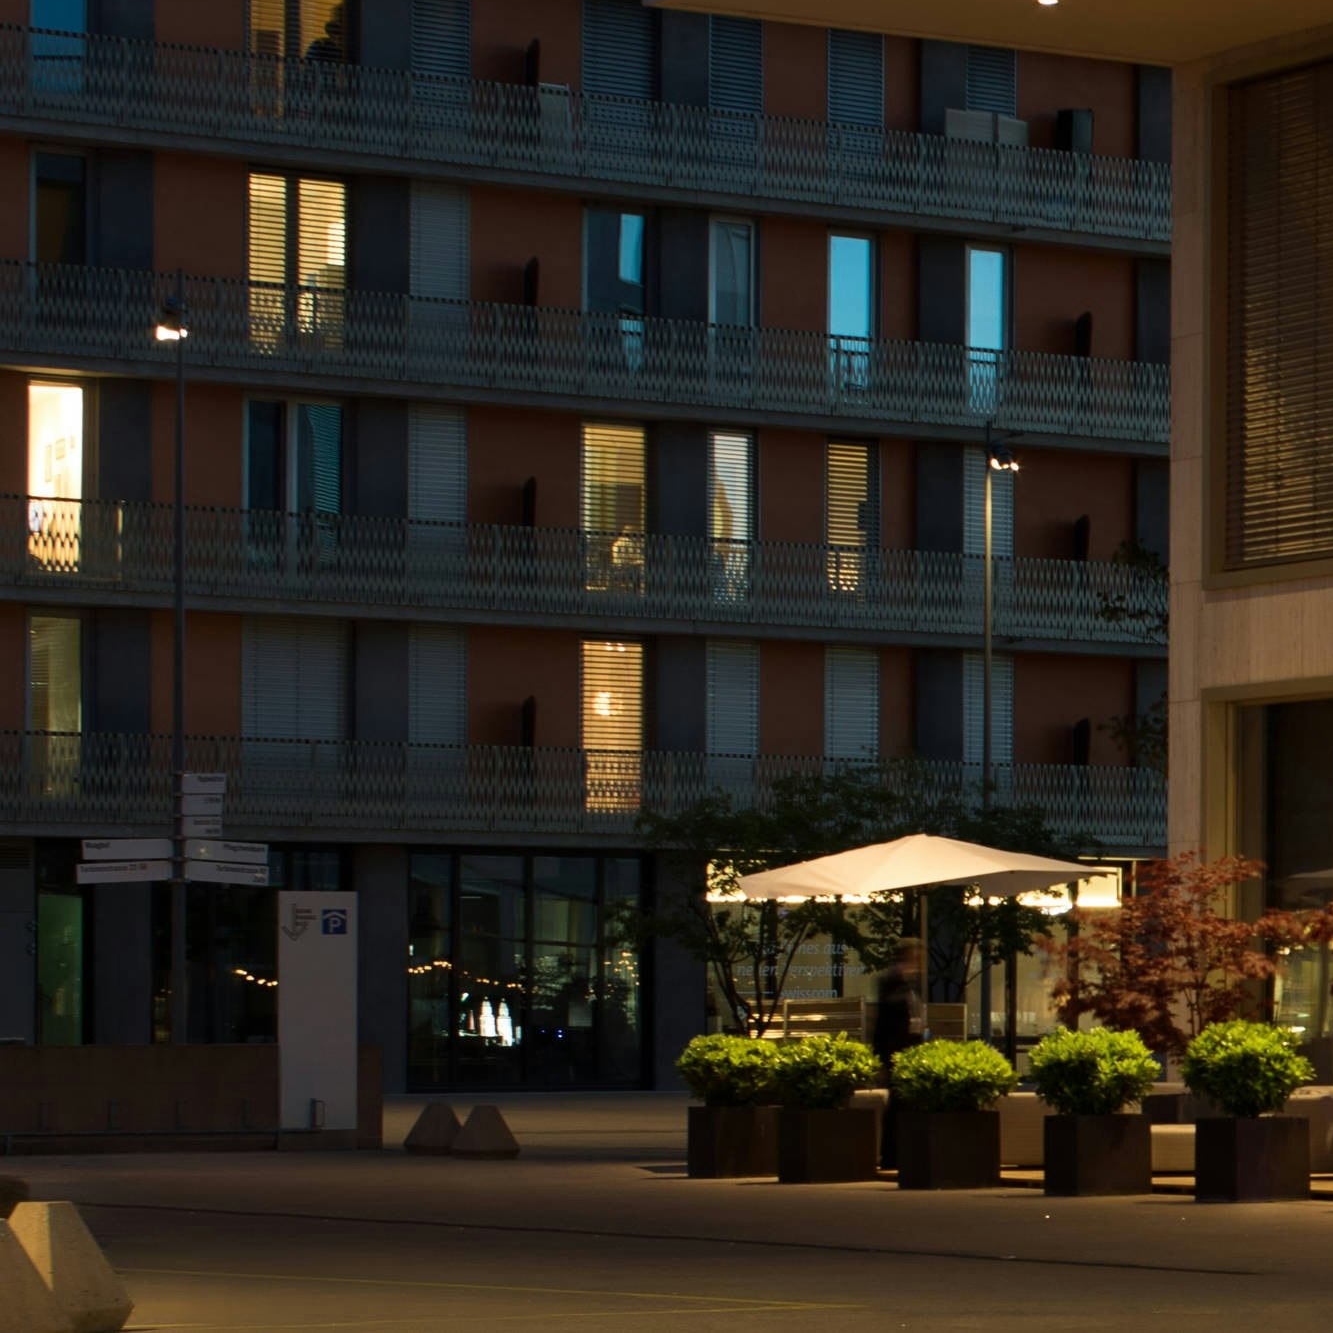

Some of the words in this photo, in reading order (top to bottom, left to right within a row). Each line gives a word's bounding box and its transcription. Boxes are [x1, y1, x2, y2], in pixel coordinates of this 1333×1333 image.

[328, 917, 342, 933] P
[737, 965, 778, 977] neen
[786, 962, 868, 979] erspektiven
